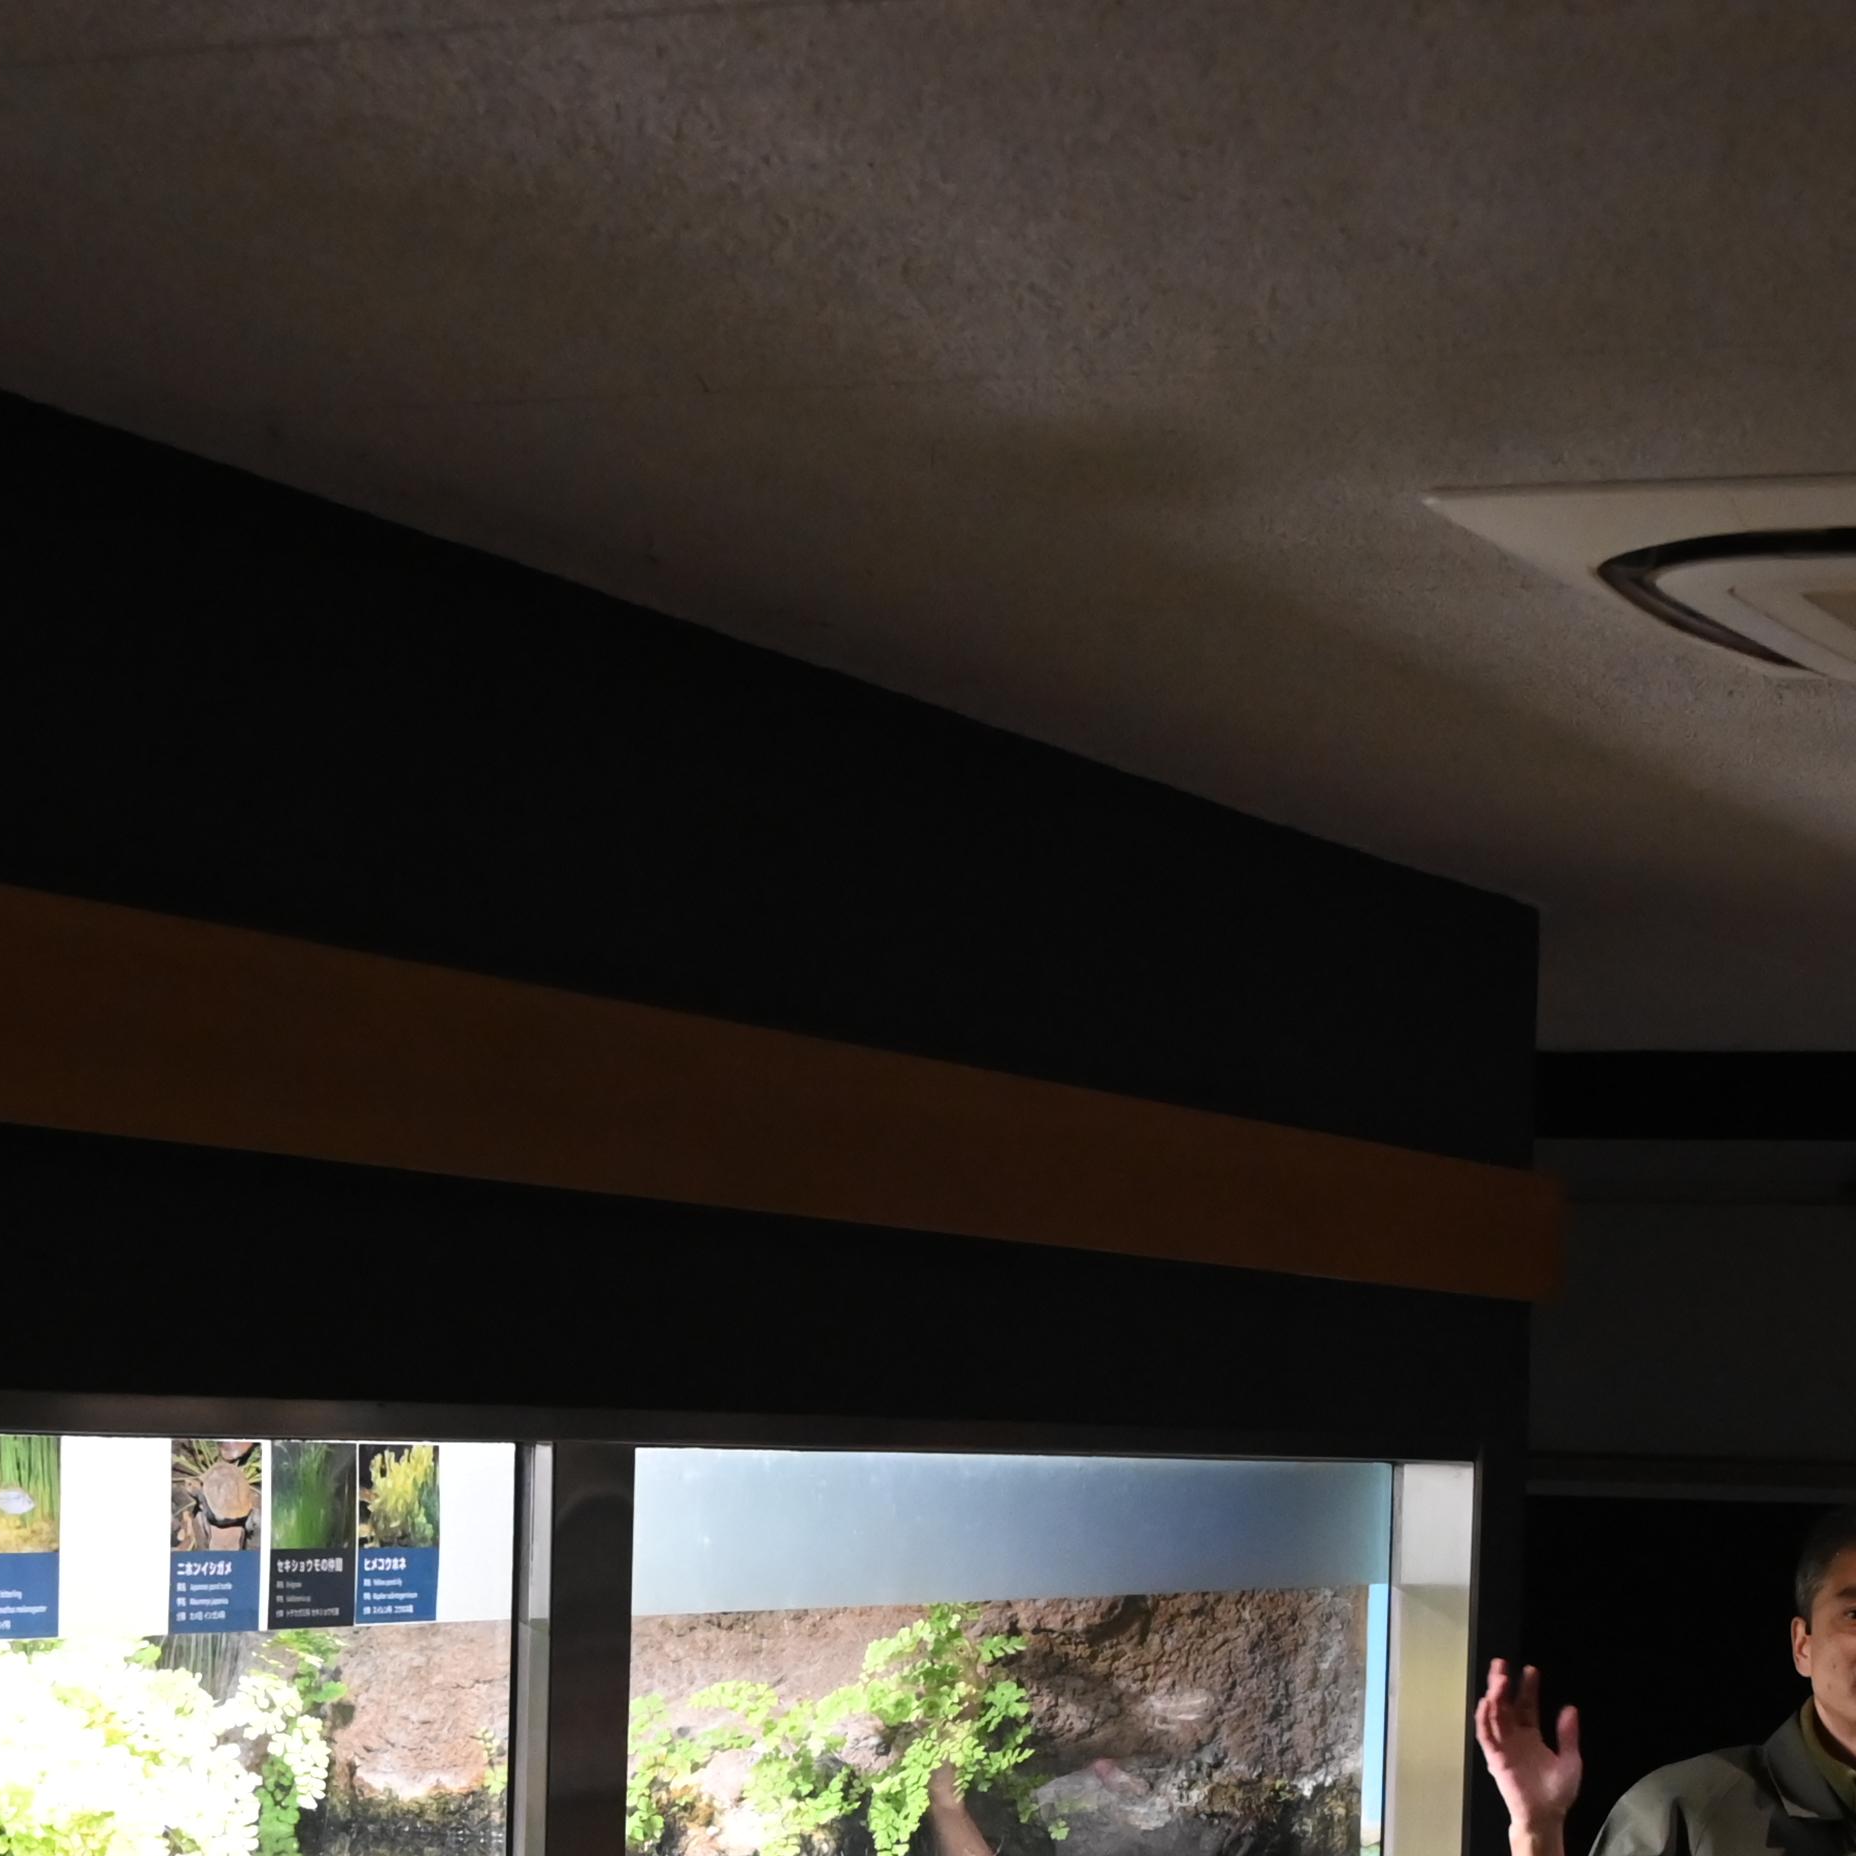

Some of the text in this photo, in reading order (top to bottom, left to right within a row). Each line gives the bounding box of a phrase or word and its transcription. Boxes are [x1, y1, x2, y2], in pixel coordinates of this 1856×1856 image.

[177, 1560, 232, 1576] ニホンイシガメ
